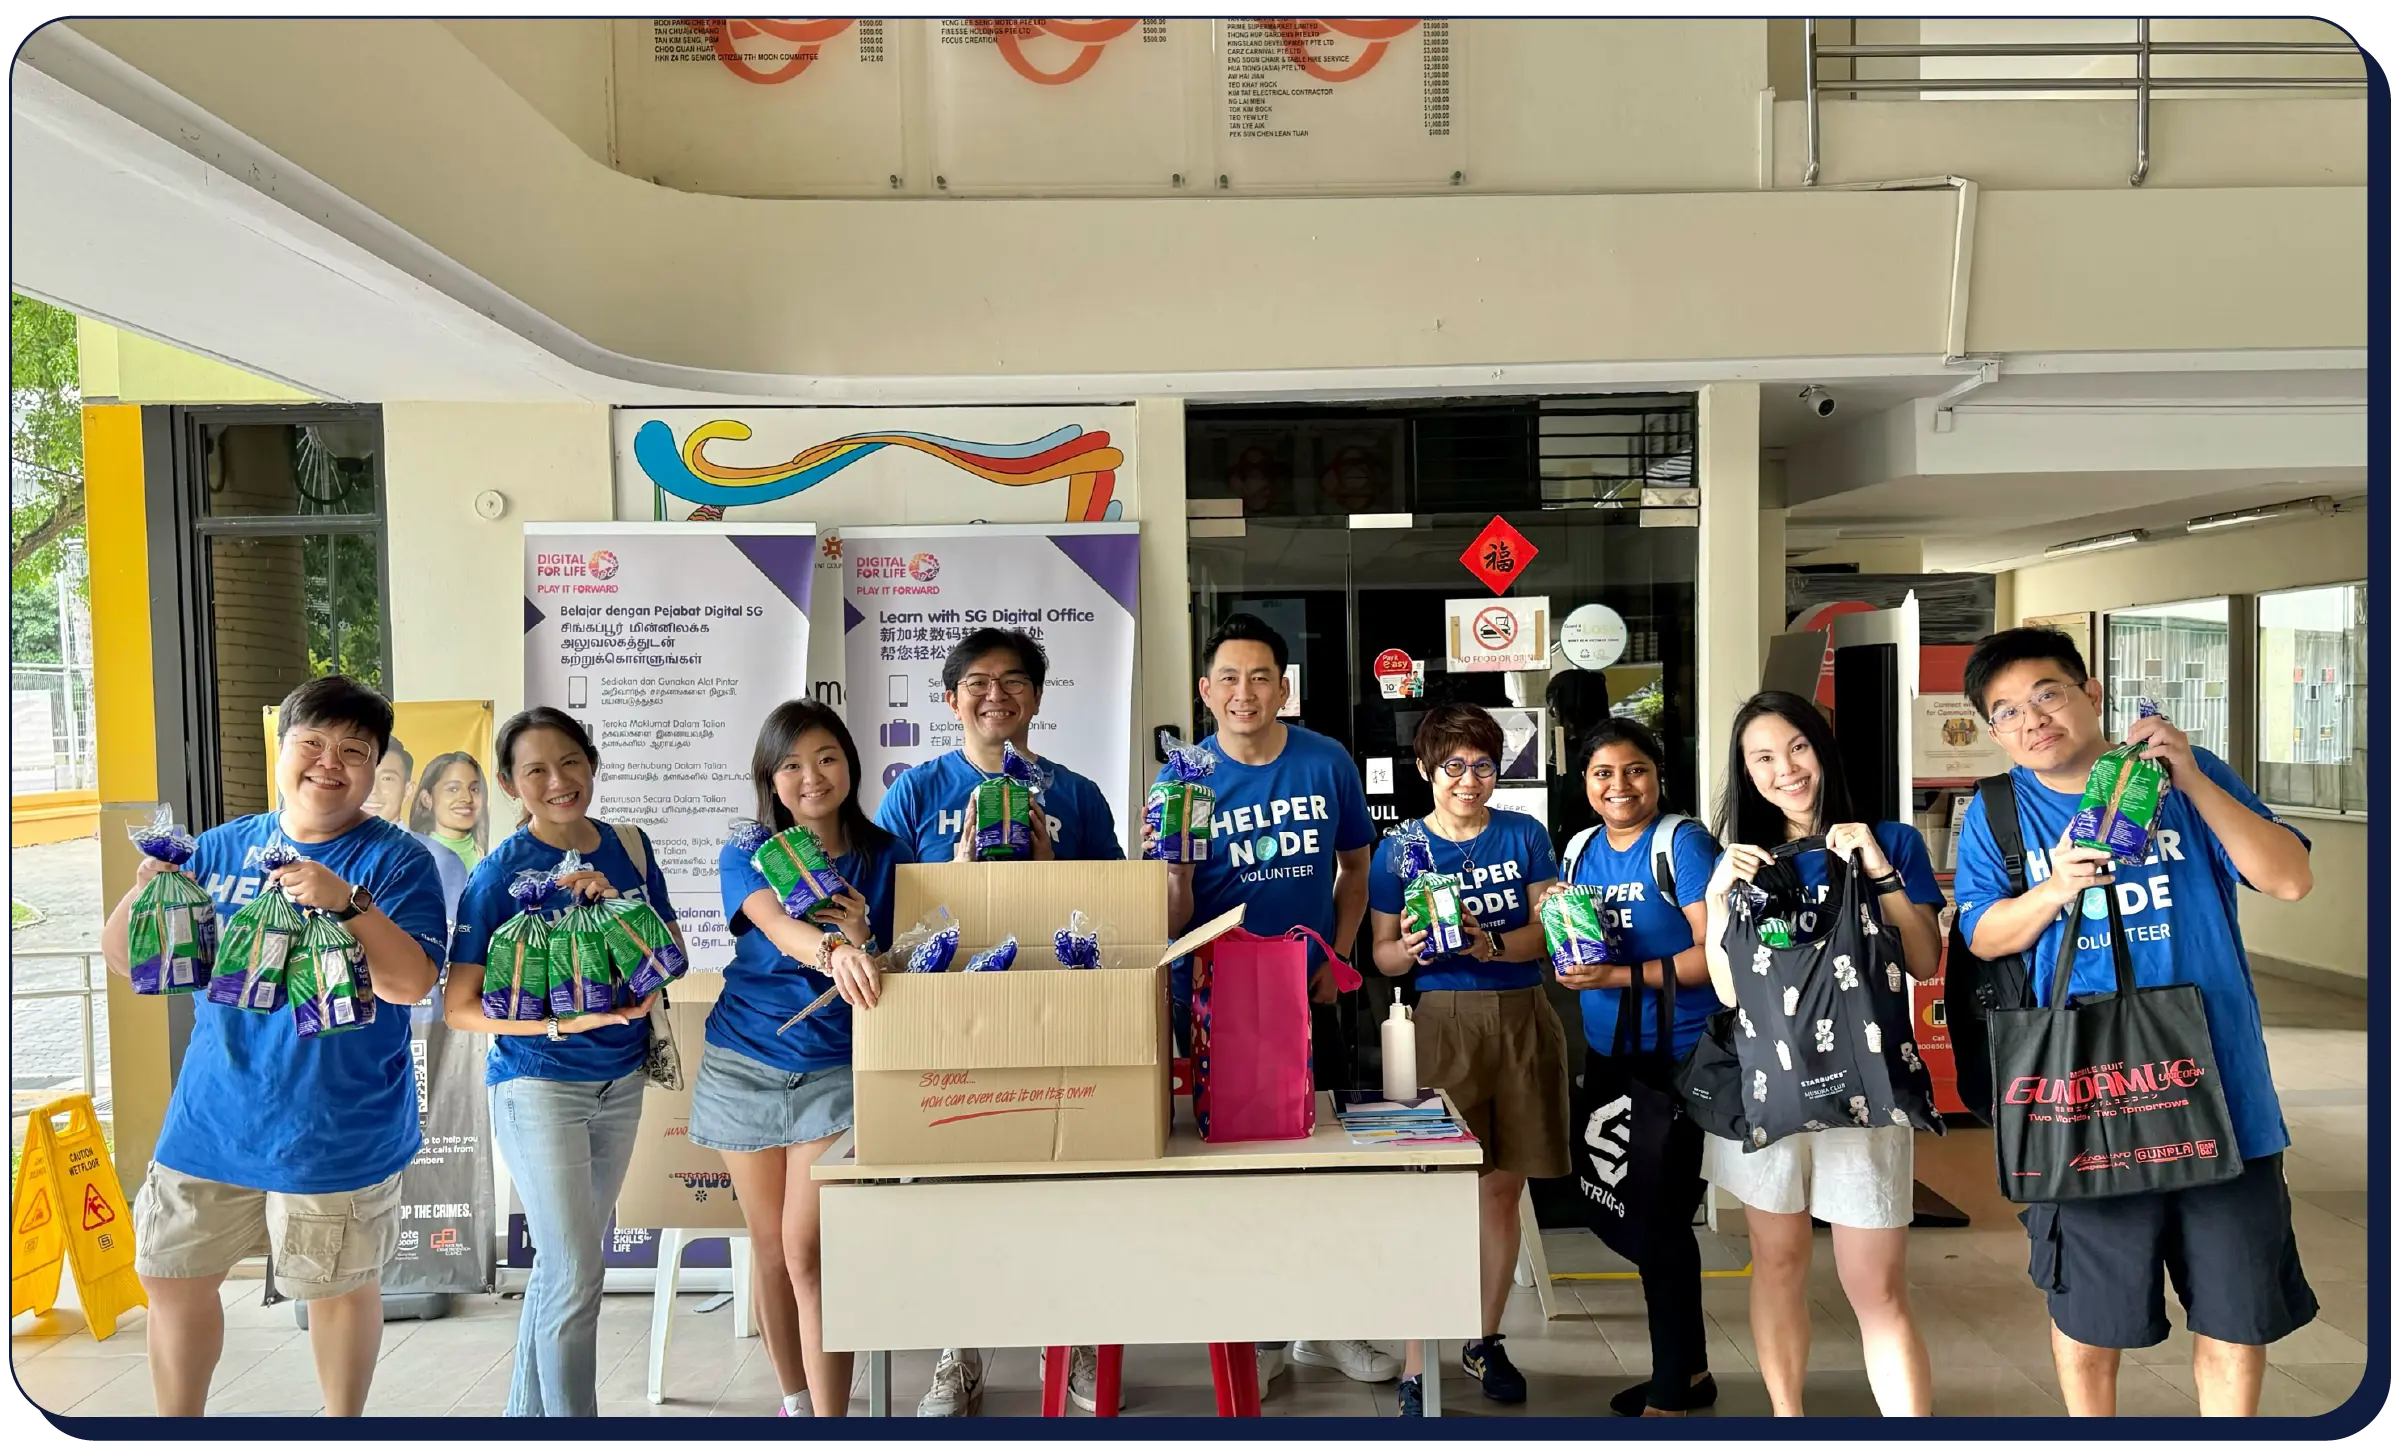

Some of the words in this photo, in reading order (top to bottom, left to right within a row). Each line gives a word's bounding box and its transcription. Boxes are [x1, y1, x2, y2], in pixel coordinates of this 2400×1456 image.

[537, 554, 586, 566] DIGITAL
[856, 556, 906, 568] DIGITAL
[1483, 542, 1514, 573] 福
[537, 566, 561, 577] FOR
[564, 566, 586, 576] LIFE
[856, 568, 880, 578] FOR
[884, 568, 906, 578] LIFE
[537, 584, 560, 594] PLAY
[562, 584, 570, 594] IT
[572, 584, 618, 594] FORWARD
[856, 586, 880, 596] PLAY
[882, 586, 890, 595] IT
[892, 586, 940, 595] FORWARD
[560, 606, 602, 618] Belajar
[606, 606, 650, 618] dengan
[654, 606, 701, 618] Pejabat
[704, 605, 742, 618] Digital
[746, 606, 764, 617] SG
[880, 610, 923, 624] Learn
[928, 610, 960, 624] with
[964, 610, 988, 624] SG
[993, 608, 1042, 624] Digital
[1046, 608, 1094, 622] Office
[601, 678, 638, 686] Sediakan
[640, 678, 656, 686] dan
[658, 678, 695, 686] Gunakan
[698, 678, 714, 686] Alat
[716, 678, 738, 686] Pintar
[1045, 678, 1075, 687] evices
[602, 720, 627, 728] Teroka
[630, 720, 670, 728] Maklumat
[673, 720, 699, 728] Dalam
[702, 720, 726, 728] Talian
[930, 722, 964, 733] Explore
[628, 762, 672, 771] Berhubung
[600, 795, 640, 803] Berurusan
[643, 795, 671, 803] Secara
[674, 795, 700, 803] Dalam
[702, 795, 726, 803] Talian
[1210, 795, 1328, 839] HELPER
[1240, 864, 1314, 884] VOLUNTEER
[1458, 860, 1522, 890] LPER
[1604, 882, 1646, 903] PER
[1464, 888, 1520, 917] ODE
[677, 908, 720, 921] rjalanan
[1607, 909, 1634, 929] DE
[1480, 919, 1506, 930] NTEER
[2077, 923, 2171, 950] OLUTEER
[2100, 1062, 2124, 1074] SUIT
[919, 1072, 940, 1088] So
[2158, 1068, 2205, 1082] UNICORN
[920, 1096, 943, 1112] you
[945, 1094, 963, 1107] can
[966, 1092, 992, 1104] even
[996, 1090, 1016, 1103] eat
[1018, 1088, 1029, 1101] it
[1030, 1089, 1043, 1100] on
[1066, 1085, 1097, 1099] own!
[2028, 1113, 2052, 1122] Two
[2094, 1109, 2117, 1118] Two
[2120, 1099, 2190, 1114] Tomorrows
[443, 1135, 461, 1145] help
[463, 1136, 478, 1144] you
[69, 1147, 94, 1163] CAUTION
[418, 1145, 432, 1154] ock
[2138, 1144, 2192, 1160] GUNPLA
[69, 1162, 82, 1177] WET
[80, 1158, 100, 1172] FLOOR
[400, 1205, 412, 1220] OP
[414, 1204, 432, 1219] THE
[433, 1203, 472, 1218] CRIMES.
[613, 1234, 644, 1244] SKILLS
[613, 1244, 630, 1253] LIFE
